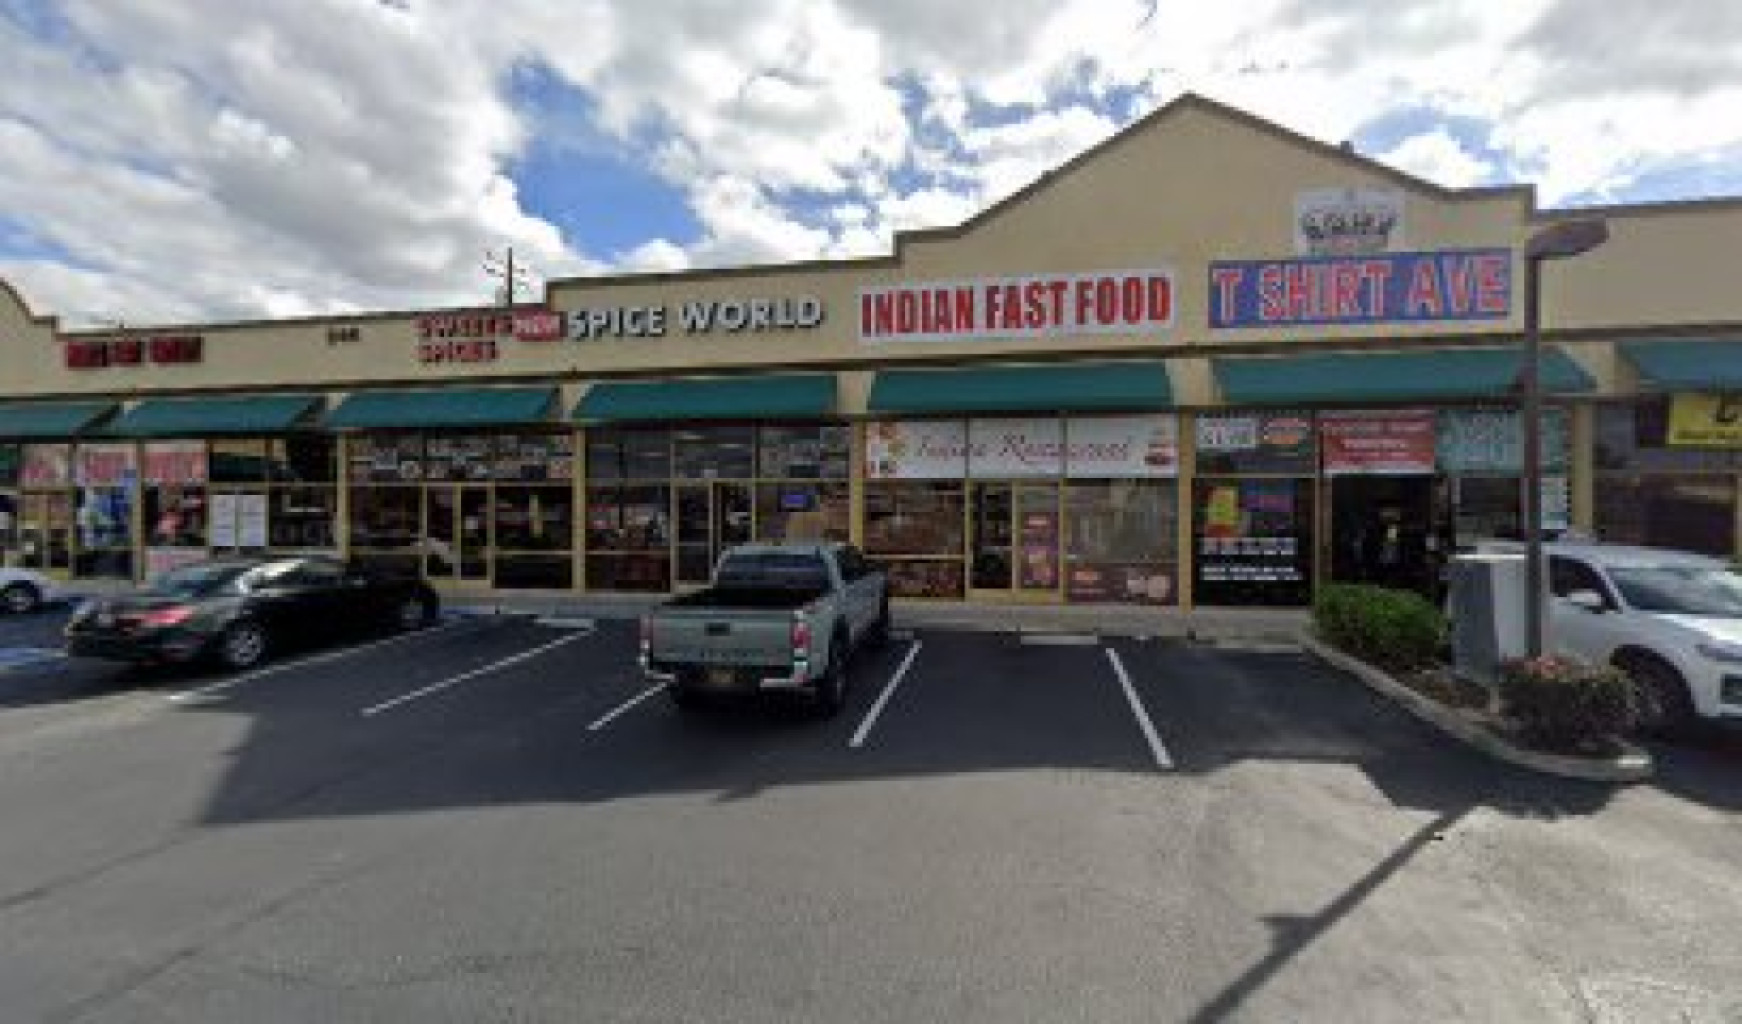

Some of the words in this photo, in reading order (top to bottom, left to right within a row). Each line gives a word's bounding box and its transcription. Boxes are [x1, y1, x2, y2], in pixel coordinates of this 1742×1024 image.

[568, 306, 666, 338] SPICE
[678, 296, 825, 334] WORLD
[861, 289, 974, 338] INDIAN
[985, 281, 1068, 330] FAST
[1075, 276, 1172, 323] FOOD
[1212, 268, 1243, 322] T
[1258, 260, 1394, 319] SHIRT
[1406, 253, 1509, 317] AVE
